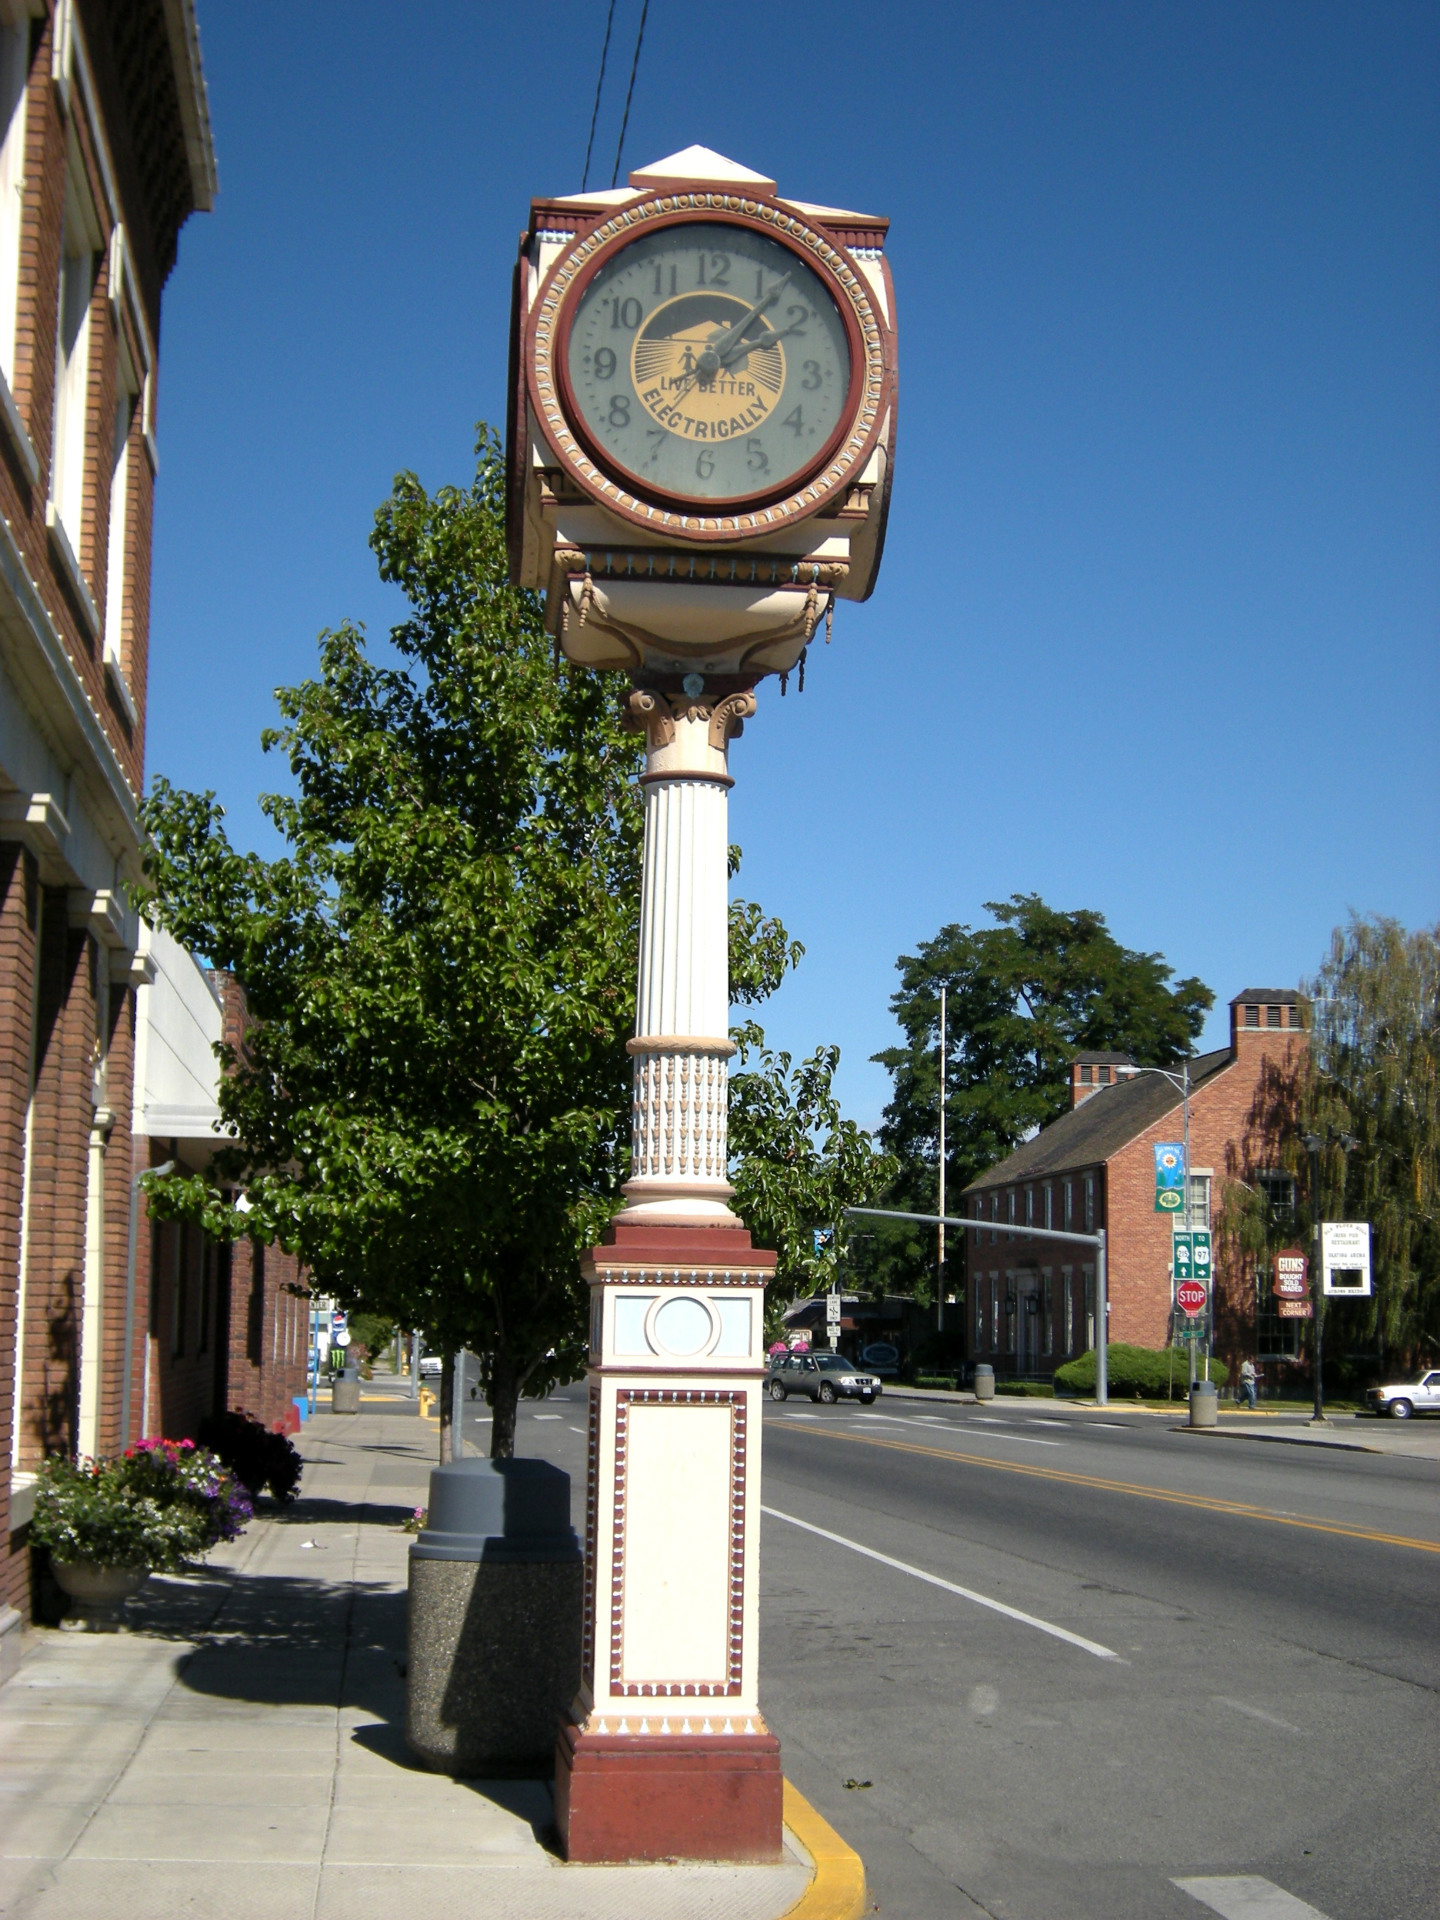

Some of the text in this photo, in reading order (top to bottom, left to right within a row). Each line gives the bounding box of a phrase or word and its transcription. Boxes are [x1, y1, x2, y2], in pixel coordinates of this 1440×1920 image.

[653, 264, 678, 295] 11
[697, 253, 731, 285] 12
[754, 269, 764, 299] 1
[611, 297, 643, 329] 10
[786, 304, 809, 336] 2
[594, 347, 617, 380] 9
[801, 360, 823, 390] 3
[660, 376, 755, 397] LIVE BETTER
[608, 395, 631, 428] 8
[642, 388, 768, 438] ELECTRICALLY
[782, 404, 804, 437] 4
[647, 430, 668, 461] 7
[746, 438, 769, 471] 5
[695, 449, 716, 481] 6
[1178, 1250, 1188, 1258] 215
[1197, 1251, 1207, 1260] 97
[1278, 1257, 1304, 1272] GUNS
[1179, 1291, 1205, 1303] STOP
[1280, 1285, 1303, 1293] TRADED
[1282, 1308, 1307, 1316] CORNER
